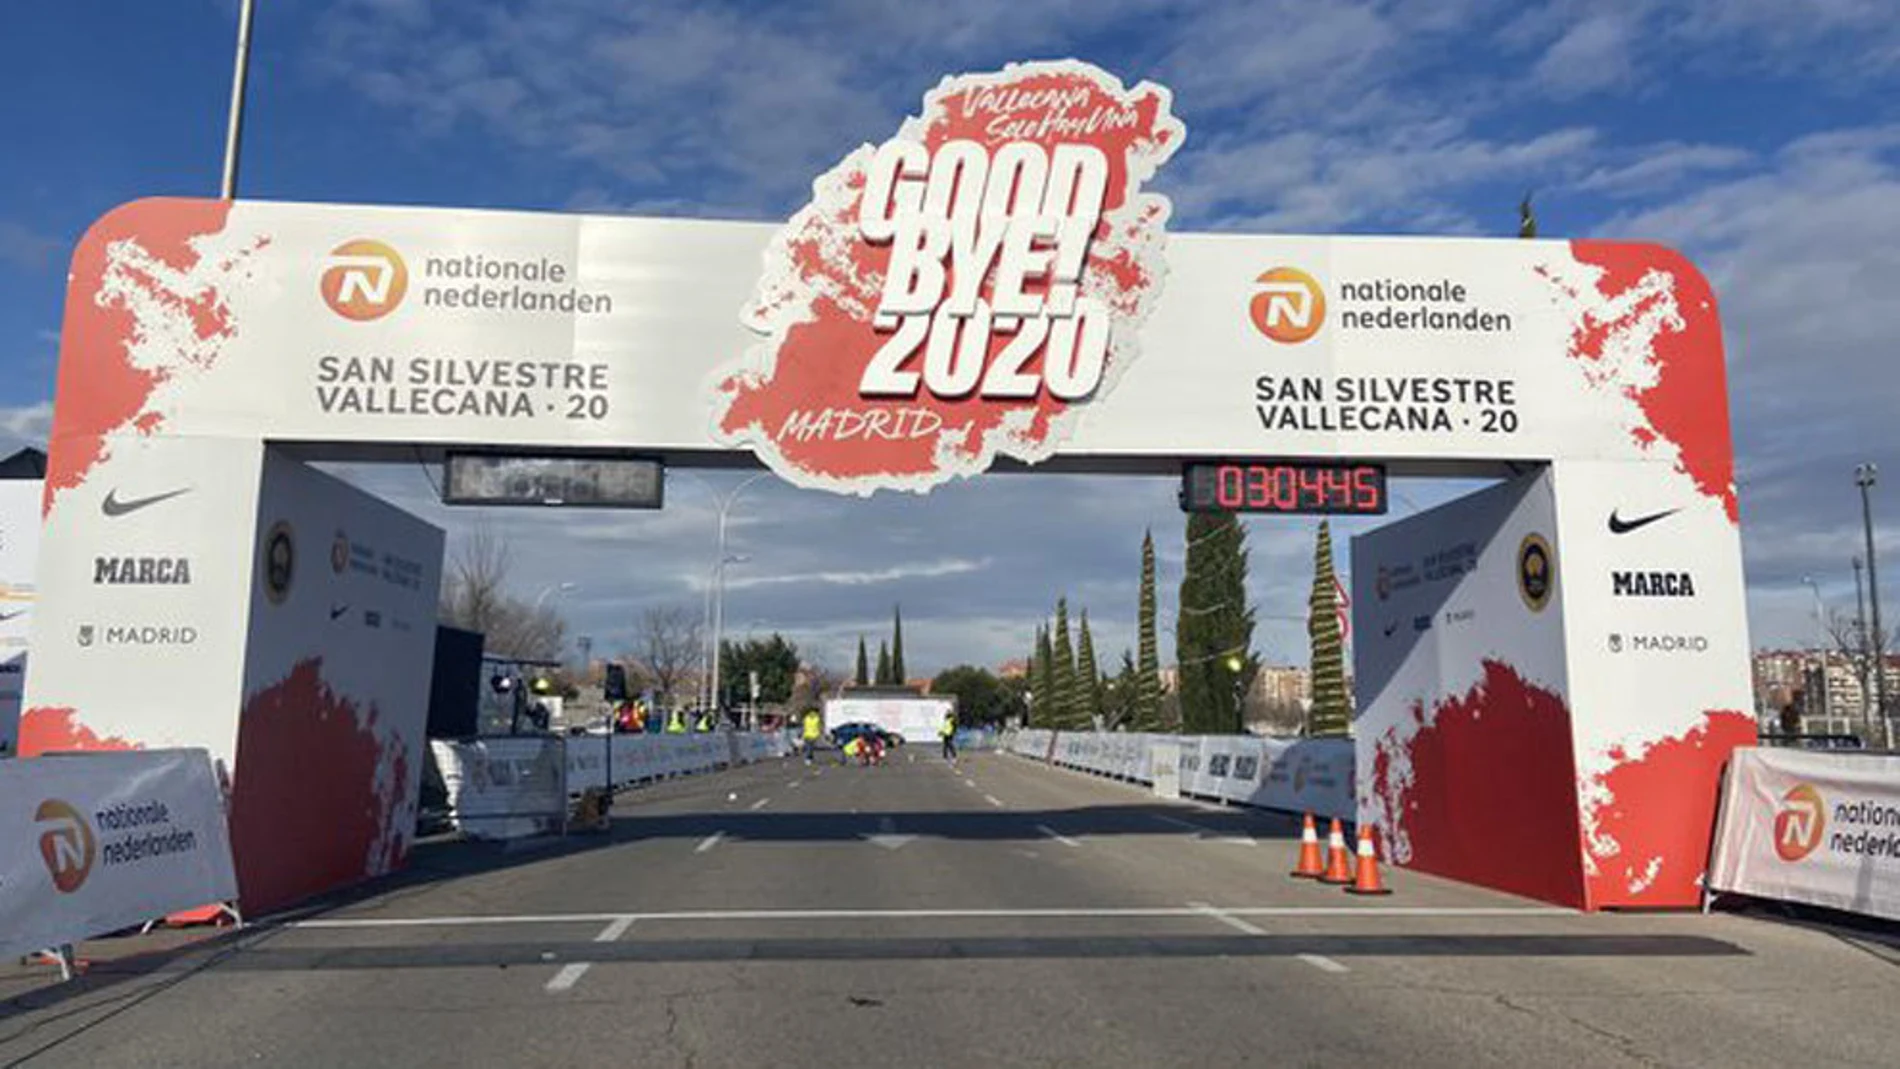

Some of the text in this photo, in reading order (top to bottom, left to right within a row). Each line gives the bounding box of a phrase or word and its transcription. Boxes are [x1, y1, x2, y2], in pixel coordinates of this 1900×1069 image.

[858, 140, 1109, 246] GOOD
[425, 253, 566, 283] nationale
[876, 215, 1088, 318] BYE!
[424, 285, 612, 313] nederlanden
[1341, 280, 1466, 302] nationale
[1342, 306, 1511, 331] nederlanden
[857, 297, 1111, 402] 2020
[317, 356, 609, 390] SAN SILVESTRE
[316, 386, 534, 418] VALLECANA
[566, 394, 609, 419] 20
[1256, 376, 1515, 405] SAN SILVESTRE
[776, 407, 943, 442] MADRID
[1256, 405, 1453, 431] VALLECANA
[1480, 410, 1518, 433] 20
[93, 557, 191, 585] MARCA
[1611, 571, 1695, 596] MARCA
[106, 627, 198, 644] MADRID
[1633, 636, 1708, 652] MADRID
[96, 801, 169, 830] nationale
[103, 827, 197, 866] nederlanden
